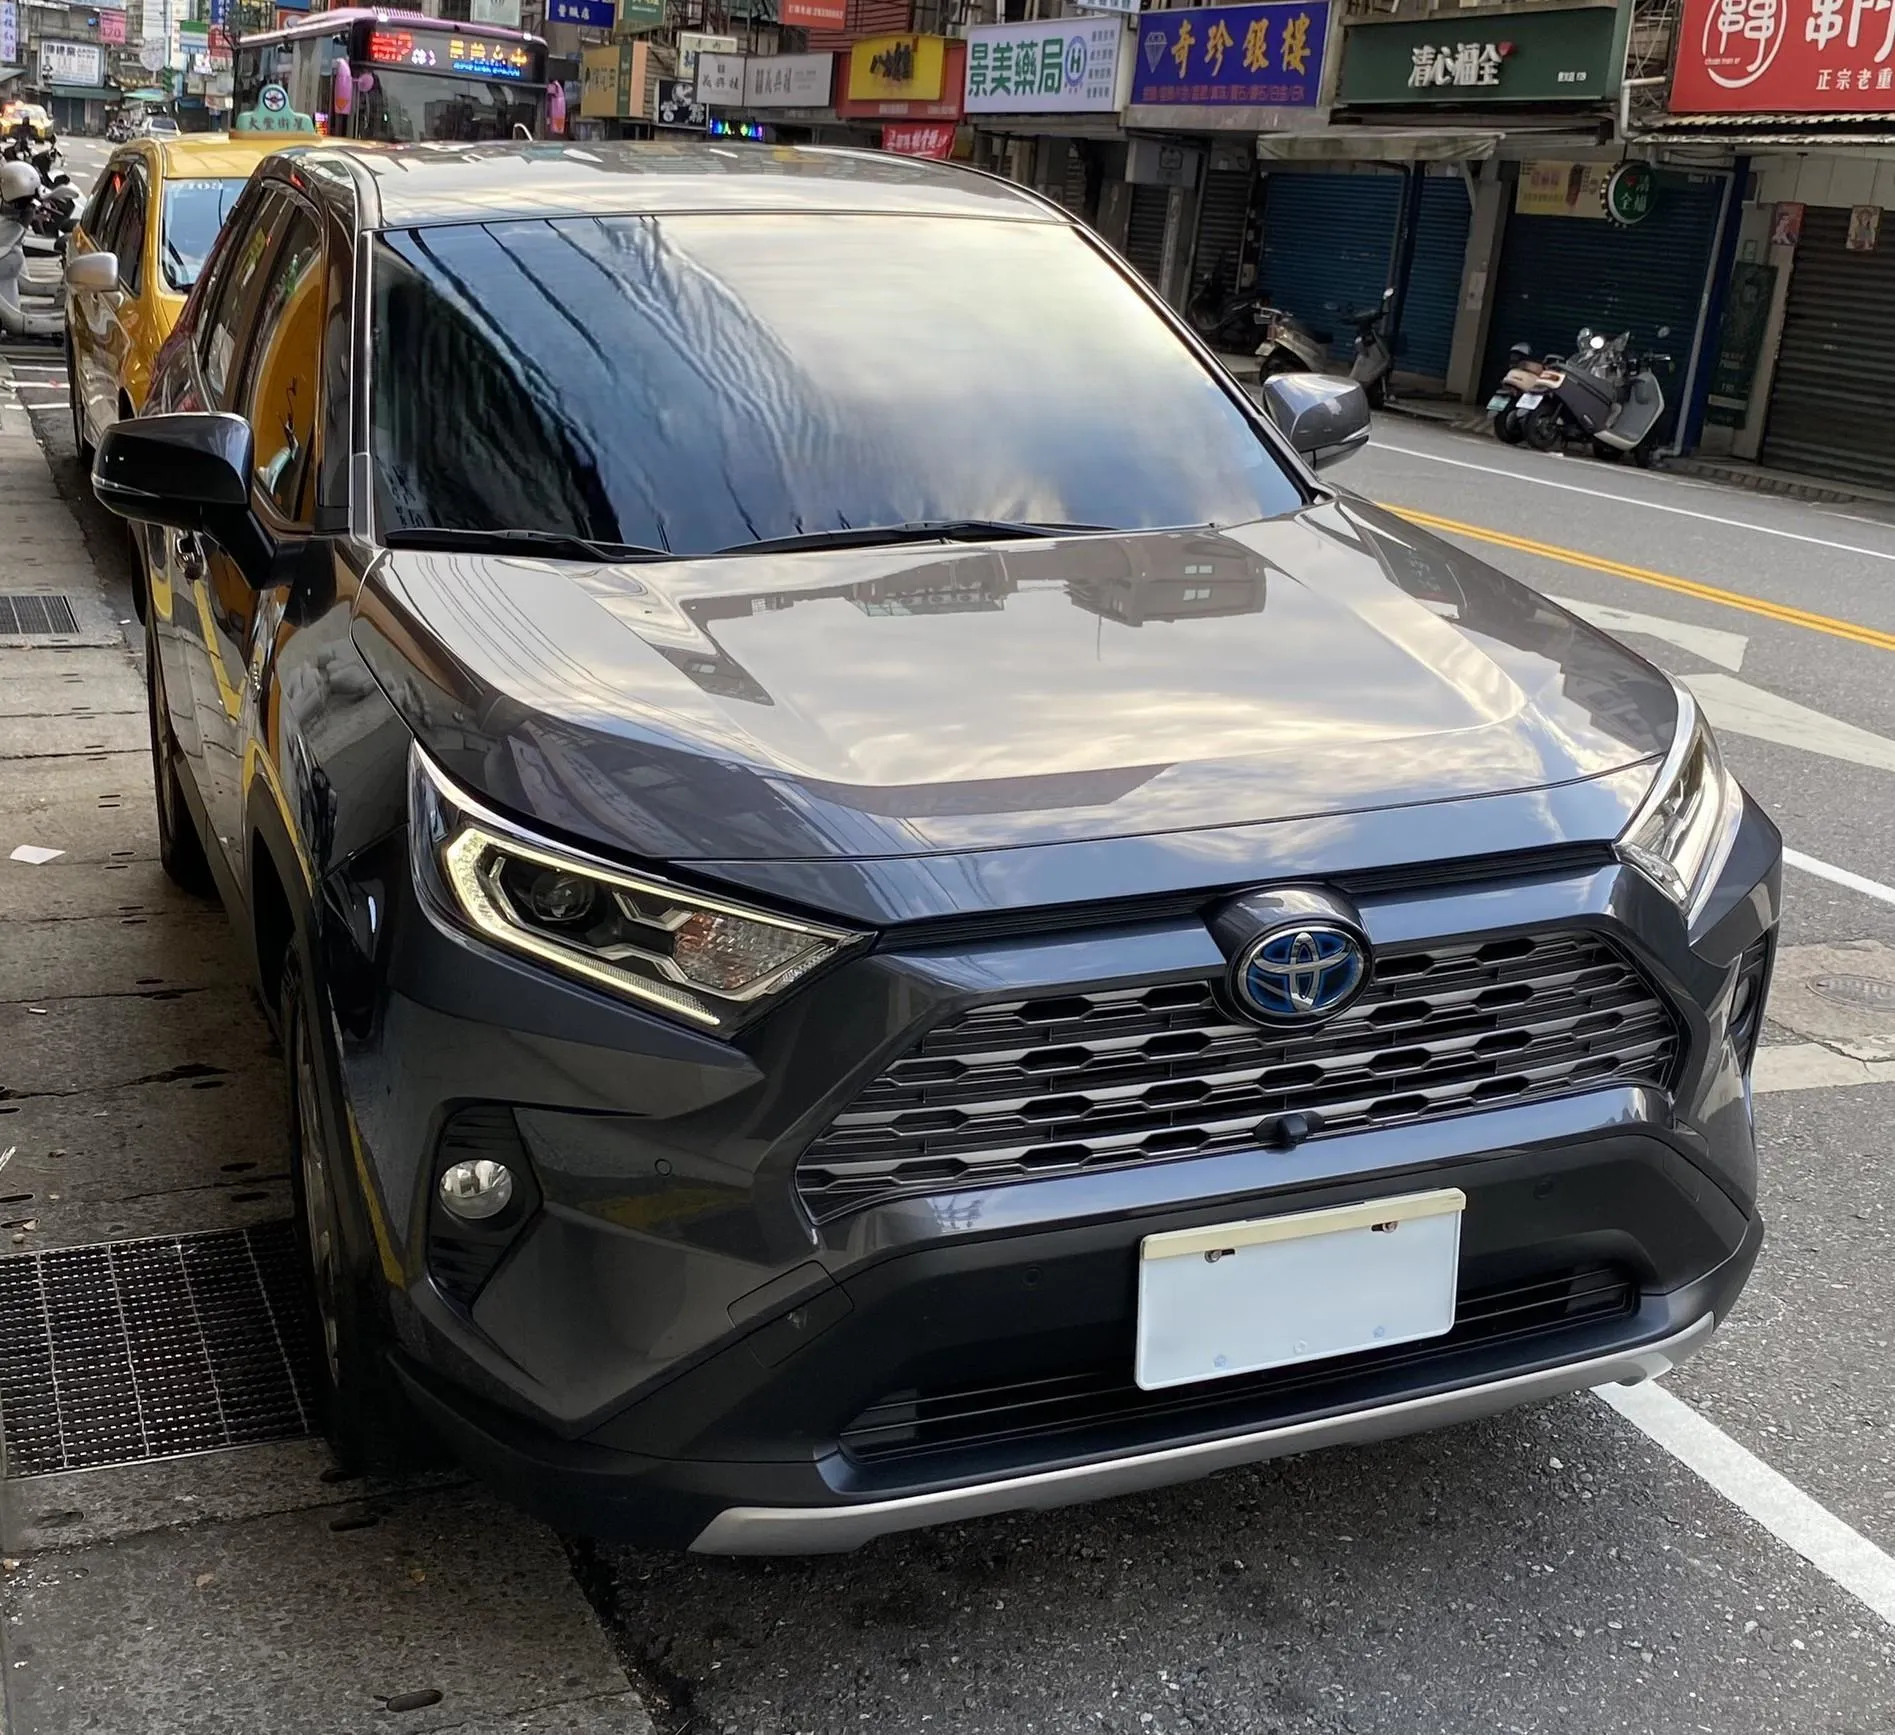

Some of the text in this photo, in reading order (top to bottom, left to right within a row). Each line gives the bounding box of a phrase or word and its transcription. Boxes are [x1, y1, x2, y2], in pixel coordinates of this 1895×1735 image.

[968, 38, 1064, 97] 景美藥局
[1171, 12, 1311, 79] 奇珍銀樓
[1408, 42, 1502, 88] 清心福全
